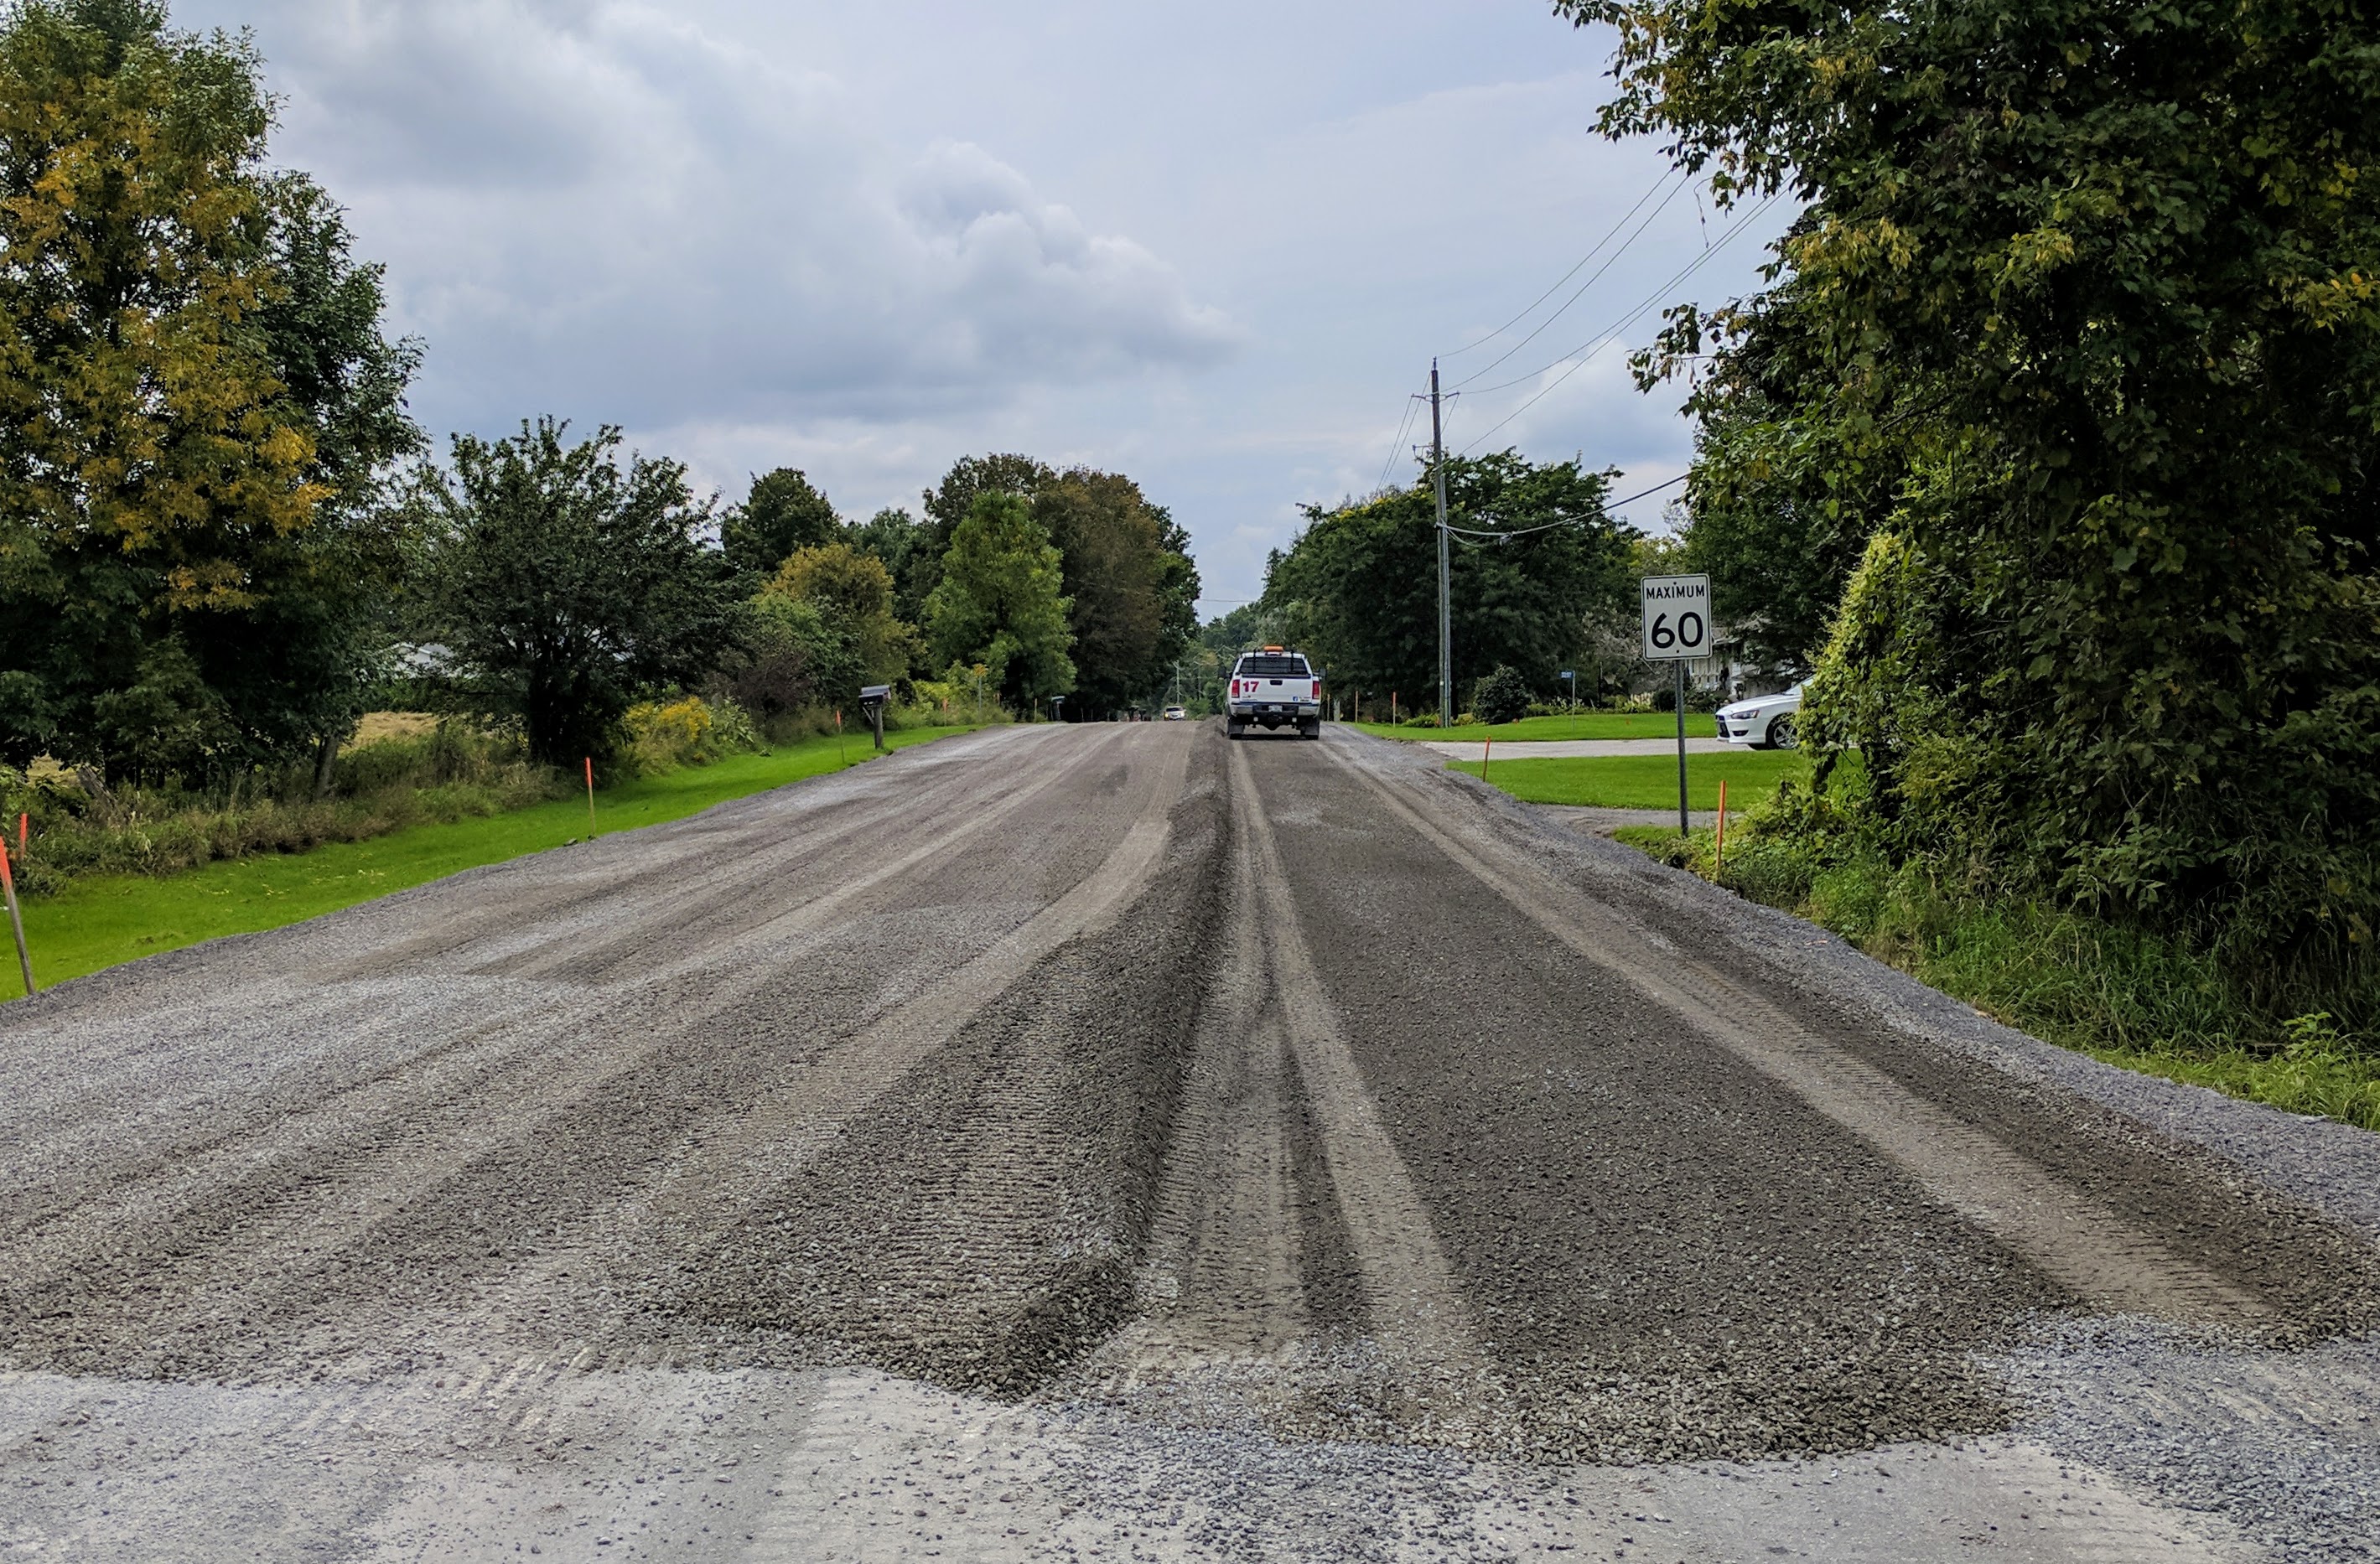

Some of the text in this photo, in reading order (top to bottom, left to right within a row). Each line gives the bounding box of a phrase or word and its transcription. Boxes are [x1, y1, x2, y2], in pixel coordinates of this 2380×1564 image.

[1646, 584, 1705, 600] MAXIMUM
[1651, 611, 1703, 649] 60
[1242, 681, 1259, 692] 17
